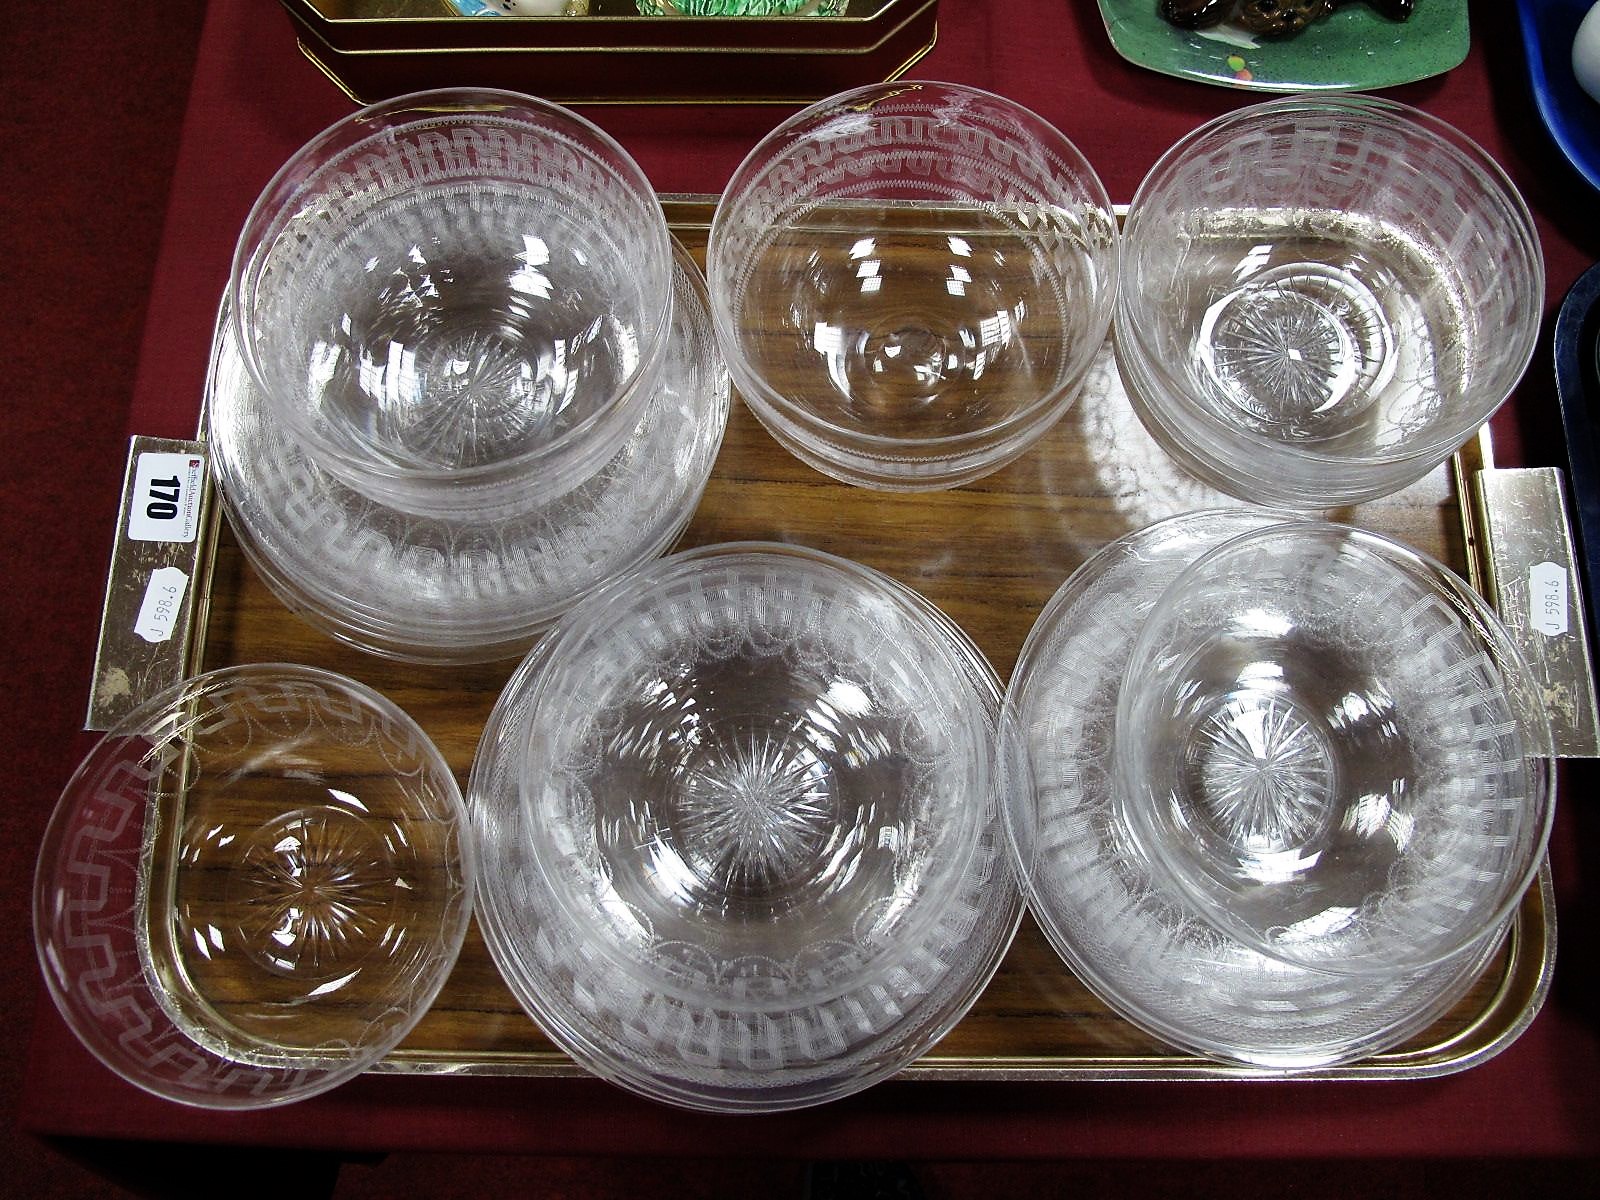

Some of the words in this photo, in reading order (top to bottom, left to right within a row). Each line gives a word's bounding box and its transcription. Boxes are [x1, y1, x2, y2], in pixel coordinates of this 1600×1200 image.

[146, 475, 180, 520] 170
[153, 586, 177, 622] 598.6
[1544, 580, 1560, 615] 598.6
[150, 627, 164, 637] J
[1544, 622, 1560, 630] J
